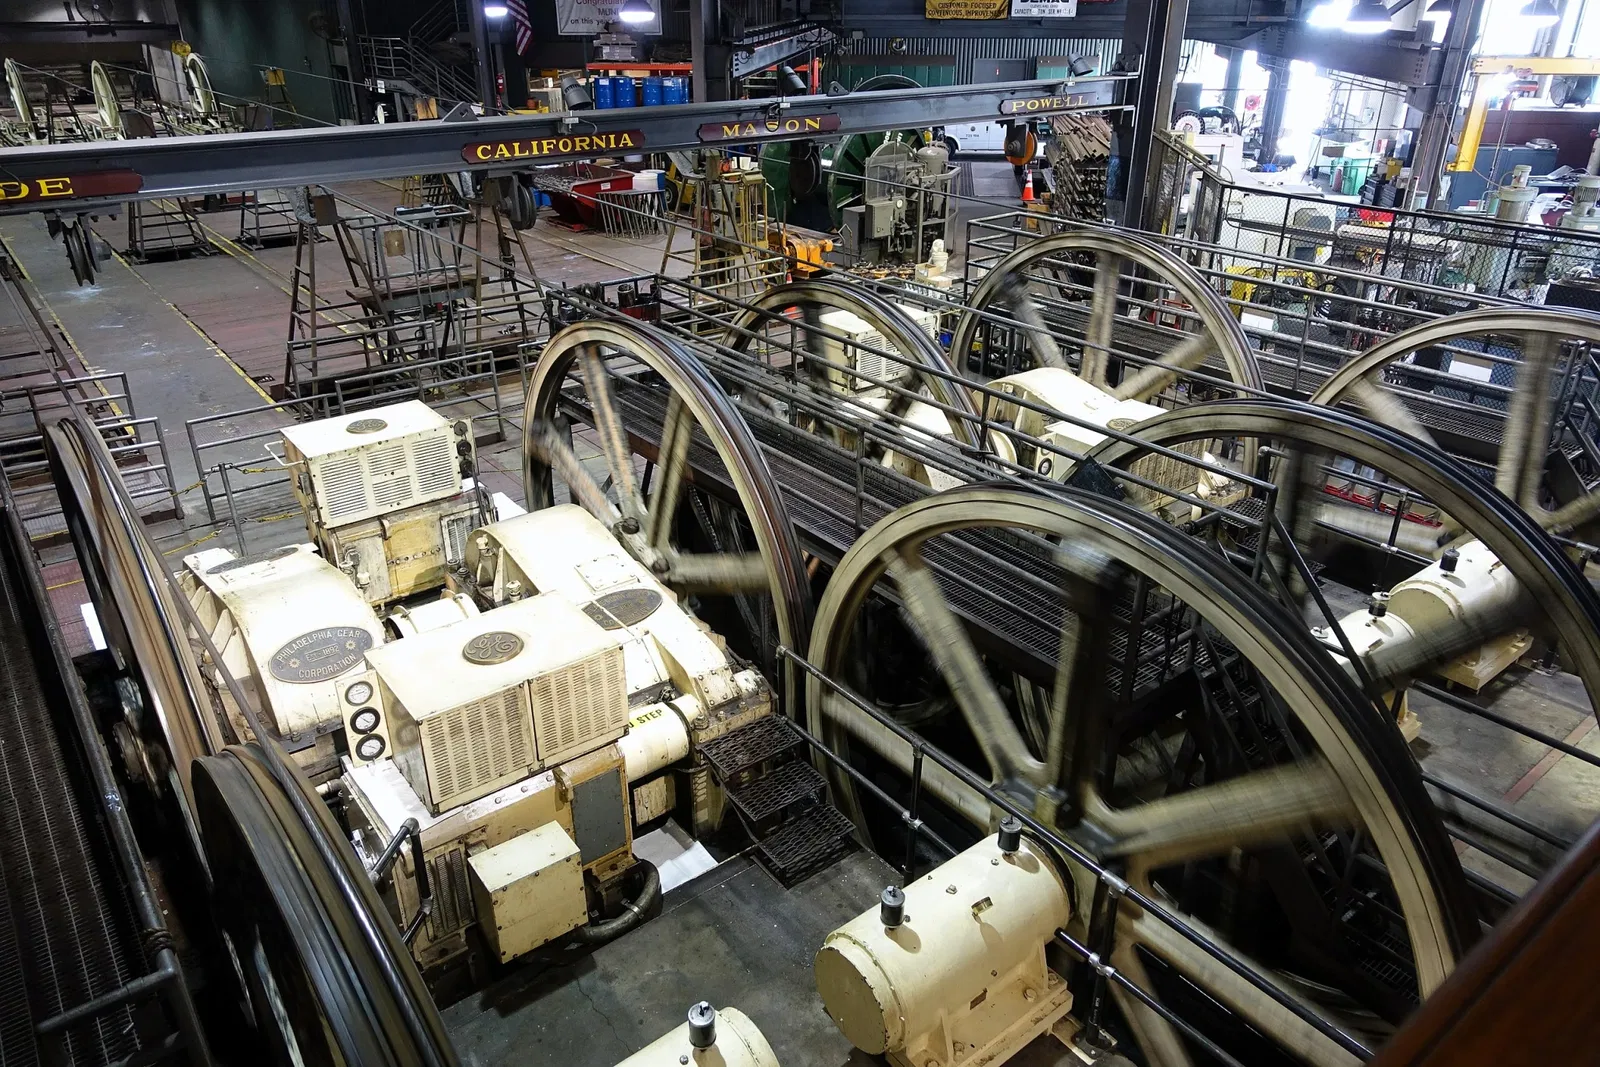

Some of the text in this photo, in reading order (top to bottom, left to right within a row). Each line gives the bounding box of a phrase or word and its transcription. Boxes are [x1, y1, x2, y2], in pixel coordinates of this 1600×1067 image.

[1011, 95, 1089, 112] POWELL
[476, 133, 634, 160] CALIFORNIA
[277, 629, 361, 663] PHILADELPHIA GEAR
[322, 645, 340, 656] 1892
[298, 653, 357, 679] CORPORATION
[636, 708, 663, 724] STEP
